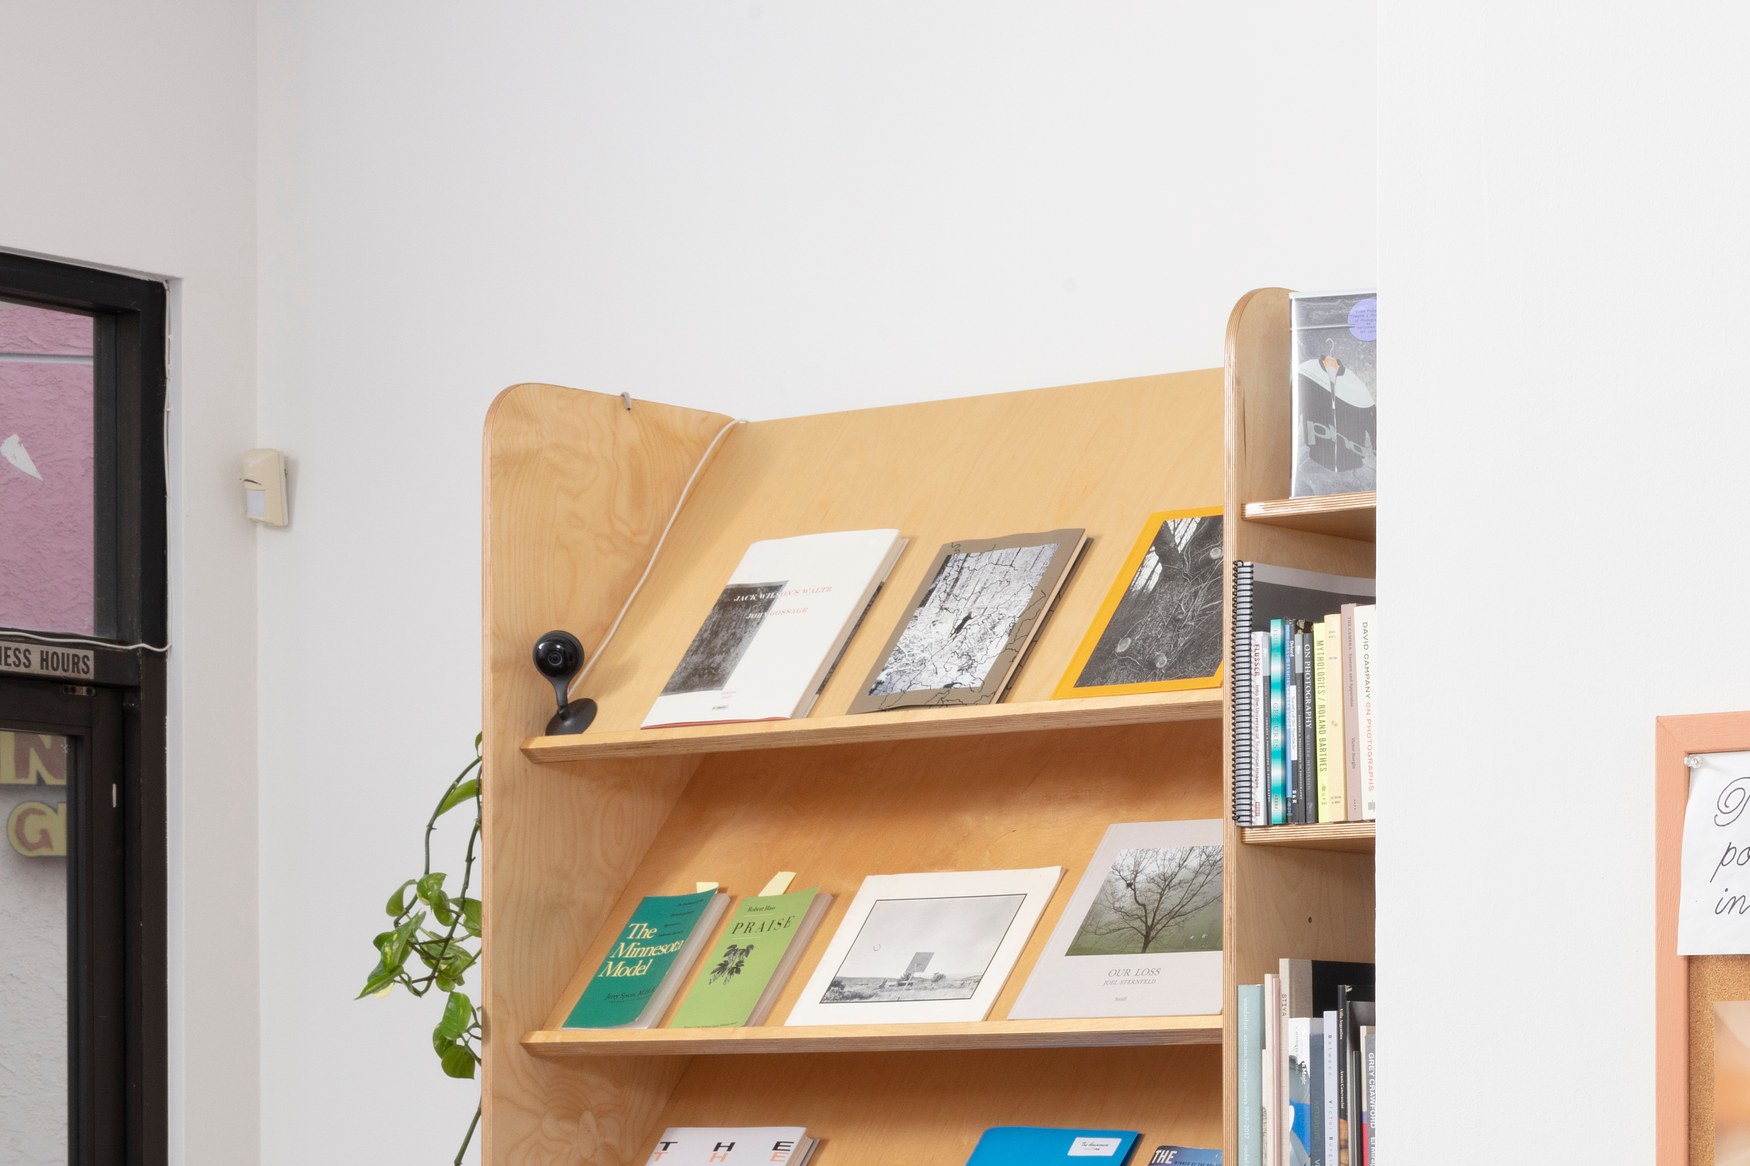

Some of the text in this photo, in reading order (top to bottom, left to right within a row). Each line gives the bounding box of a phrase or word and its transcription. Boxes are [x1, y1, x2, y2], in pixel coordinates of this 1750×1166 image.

[734, 594, 758, 602] JACK
[801, 586, 832, 595] WALTZ
[0, 646, 90, 675] ESS HOURS
[1304, 644, 1311, 658] ON
[1363, 653, 1371, 699] CAMPANY
[1316, 640, 1328, 772] MYTHOLOGIES ROLAND BARTHES
[1365, 702, 1375, 791] ON PHOTOGRAPHS
[1715, 888, 1750, 915] in
[626, 922, 658, 940] The
[731, 915, 795, 935] PRAISE
[610, 939, 686, 958] Minnesota
[599, 959, 653, 978] Model
[1108, 967, 1161, 977] OUR LOSS
[1368, 1079, 1376, 1128] CRAWFORD
[1151, 1150, 1177, 1164] THE
